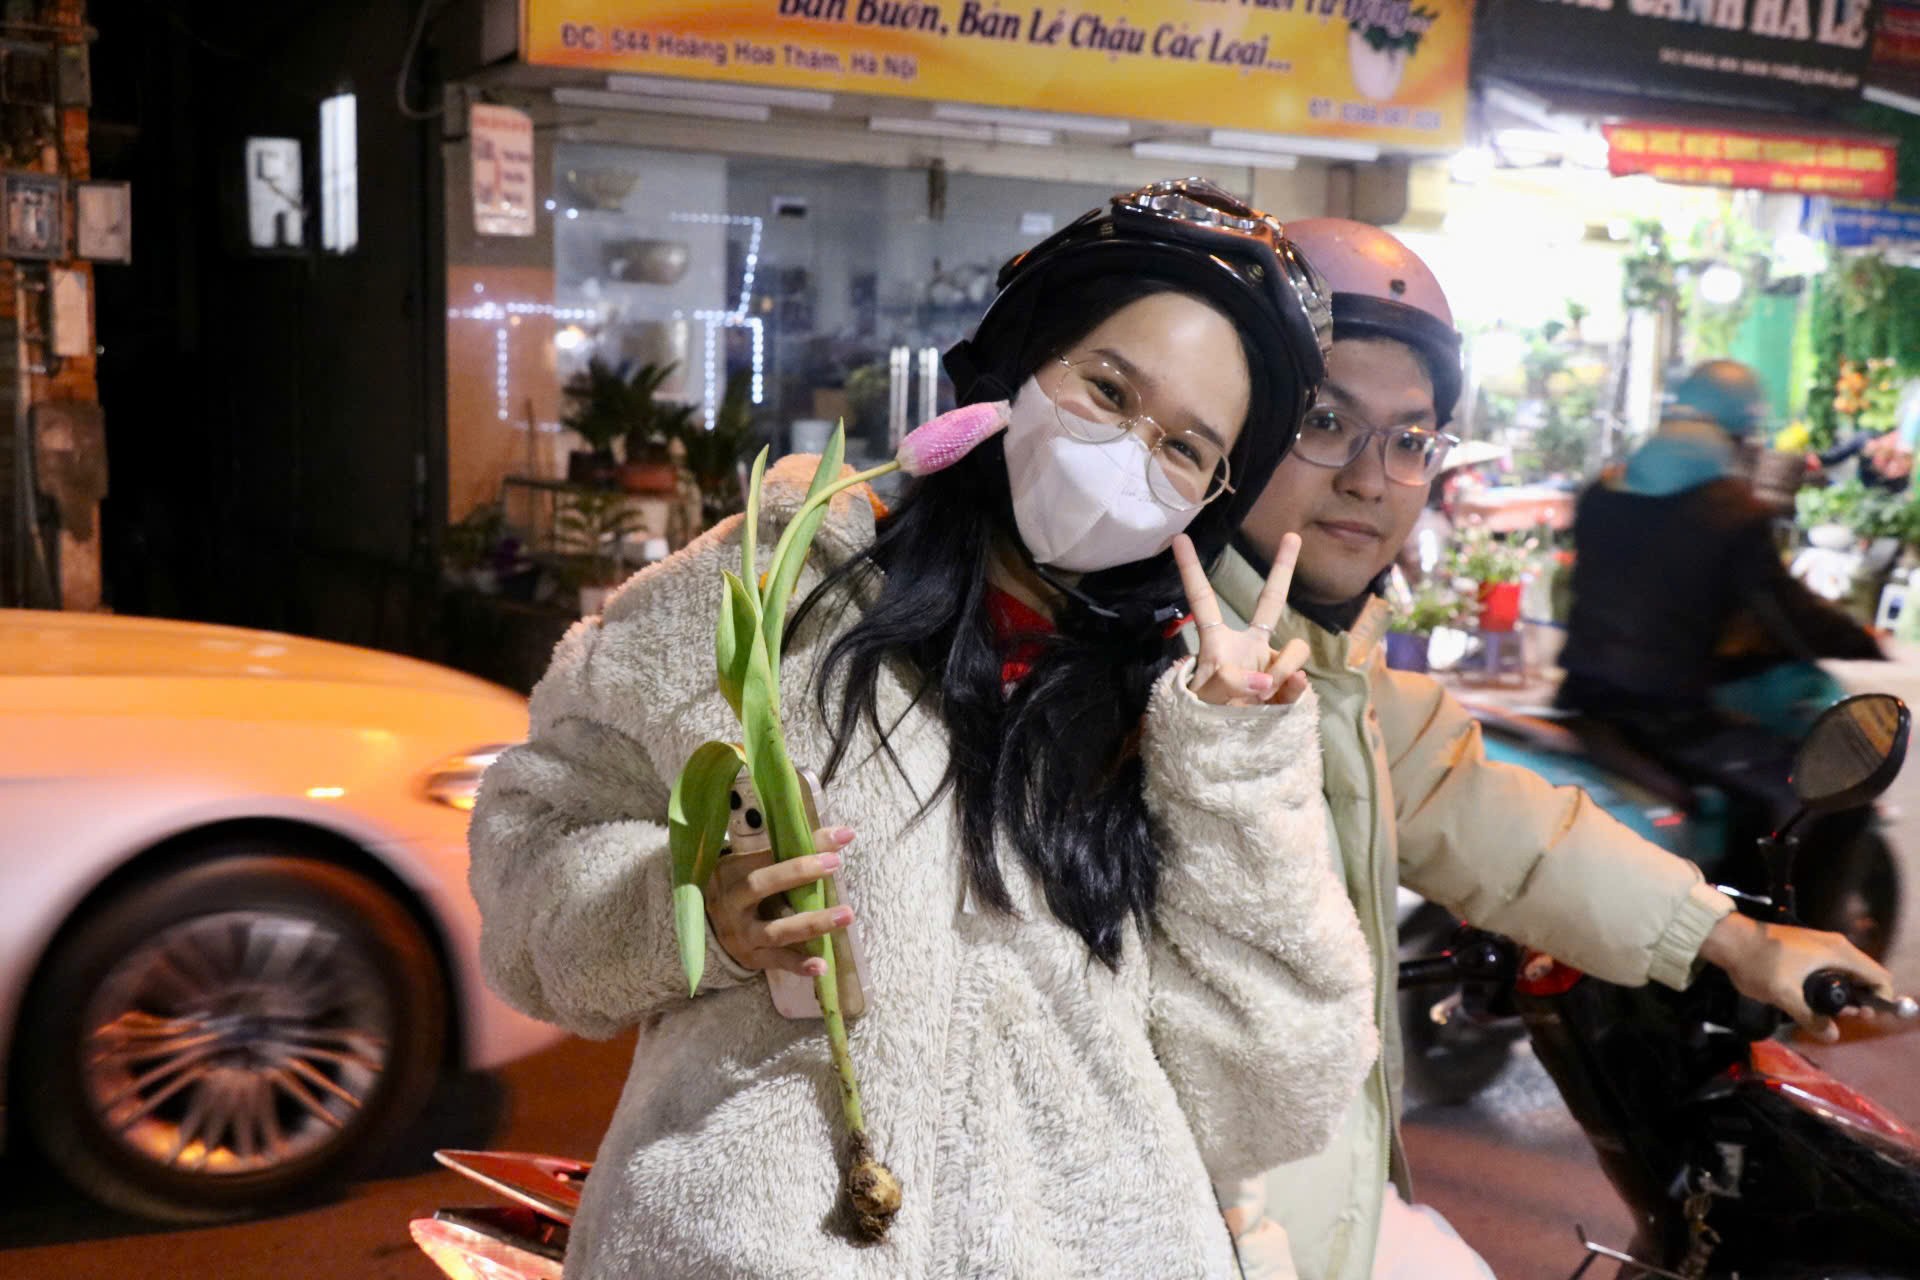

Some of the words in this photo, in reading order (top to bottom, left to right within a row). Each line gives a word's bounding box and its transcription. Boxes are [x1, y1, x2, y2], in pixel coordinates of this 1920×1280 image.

[1070, 12, 1147, 64] Chậu
[1152, 21, 1202, 60] Các
[1208, 28, 1292, 76] Loại...
